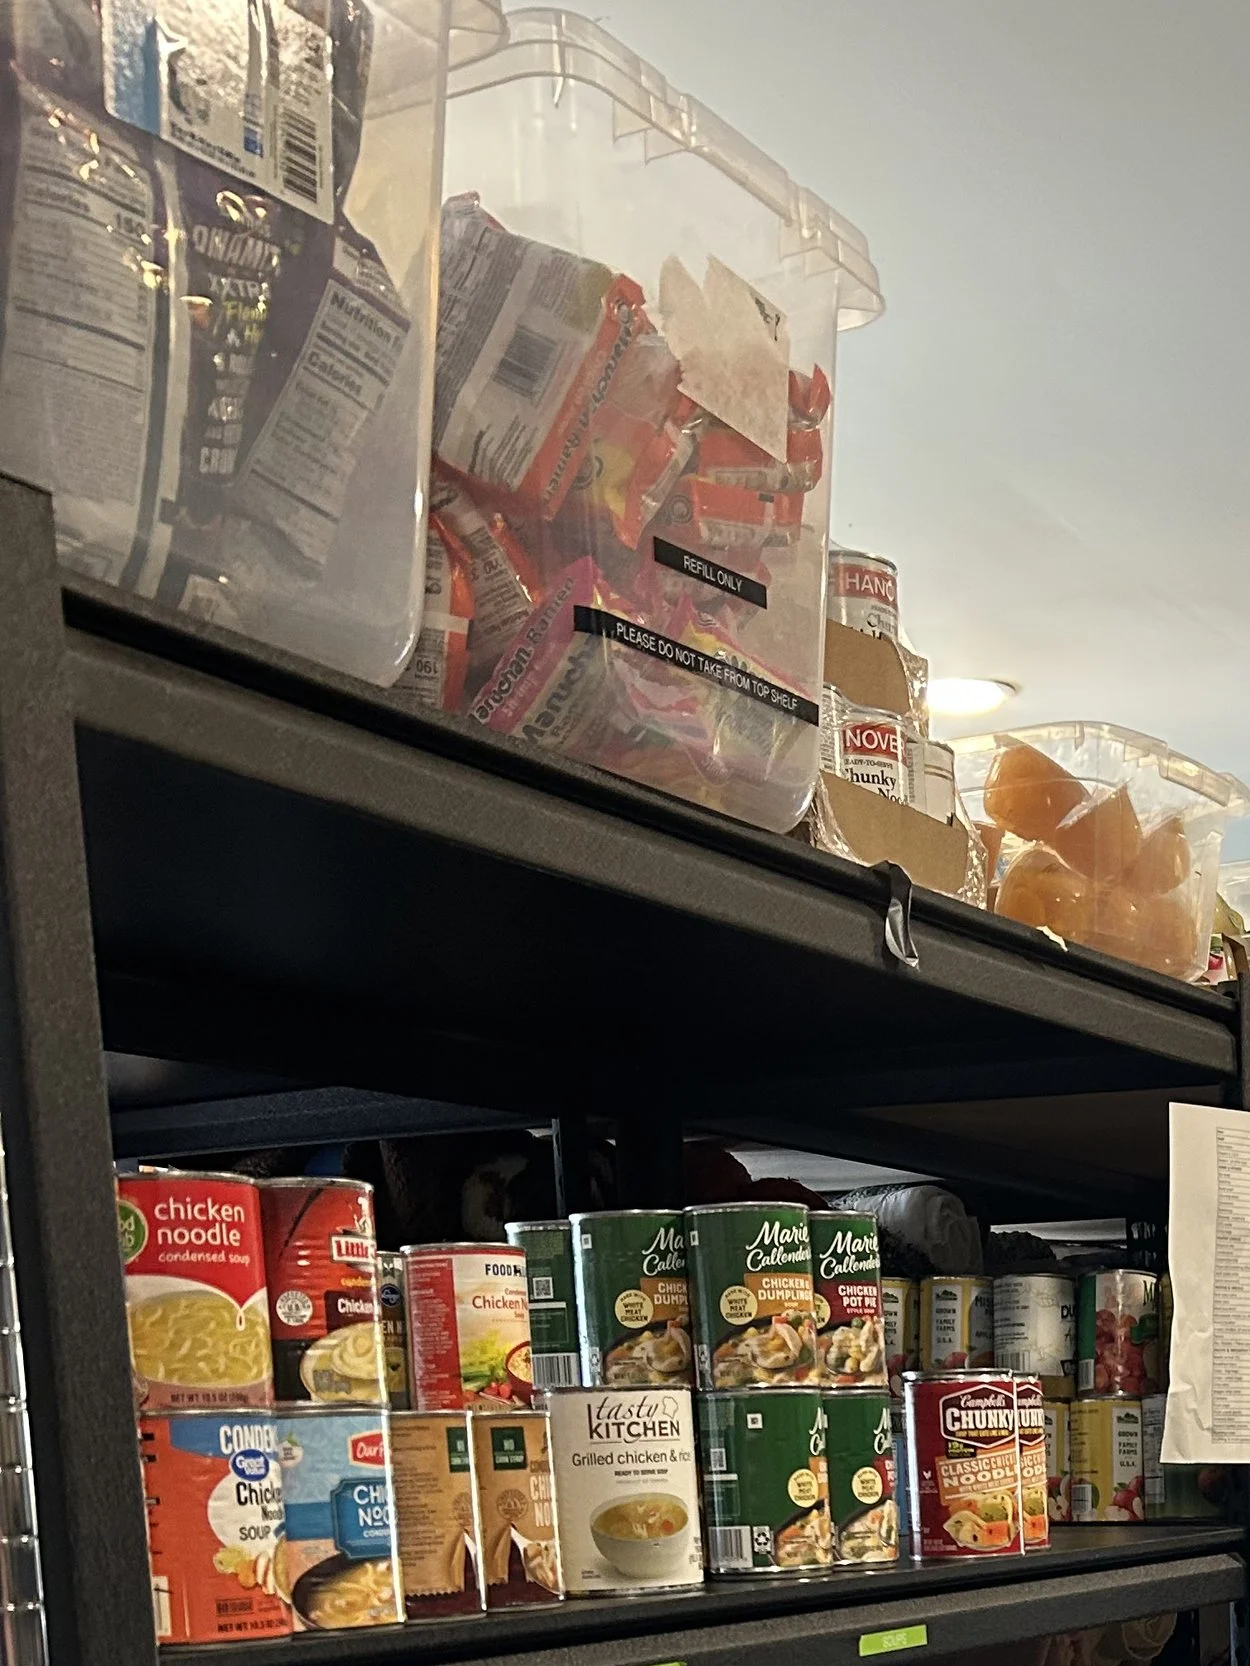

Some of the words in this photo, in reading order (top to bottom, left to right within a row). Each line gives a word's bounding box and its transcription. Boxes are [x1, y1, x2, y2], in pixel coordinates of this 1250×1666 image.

[684, 555, 715, 582] REFILL
[717, 570, 743, 593] ONLY
[616, 622, 657, 652] PLEASE
[658, 640, 674, 659] DO
[675, 647, 696, 668] NOT
[698, 656, 722, 678] TAKE
[724, 668, 751, 691] FROM
[752, 680, 770, 699] TOP
[771, 689, 798, 711] SHELF
[154, 1196, 245, 1222] chicken
[157, 1222, 241, 1247] noodle
[746, 1221, 810, 1249] Marie
[820, 1231, 878, 1259] Marie
[158, 1250, 226, 1264] condensed
[228, 1253, 250, 1268] soup
[485, 1263, 513, 1276] FOOD
[761, 1279, 802, 1289] CHICKEN
[838, 1285, 878, 1296] CHICKEN
[472, 1295, 520, 1310] Chicken
[843, 1296, 862, 1308] POT
[864, 1297, 877, 1308] PIE
[936, 1307, 957, 1315] GROWN
[596, 1395, 659, 1424] tasty
[587, 1404, 681, 1444] KITCHEN
[945, 1407, 1014, 1431] CHUNKY
[1117, 1442, 1139, 1450] FAMILY
[236, 1455, 265, 1469] Great
[572, 1451, 614, 1467] Grilled
[617, 1450, 668, 1465] chicken
[669, 1449, 678, 1463] &
[941, 1458, 990, 1477] CLASSIC
[239, 1526, 271, 1541] SOUP
